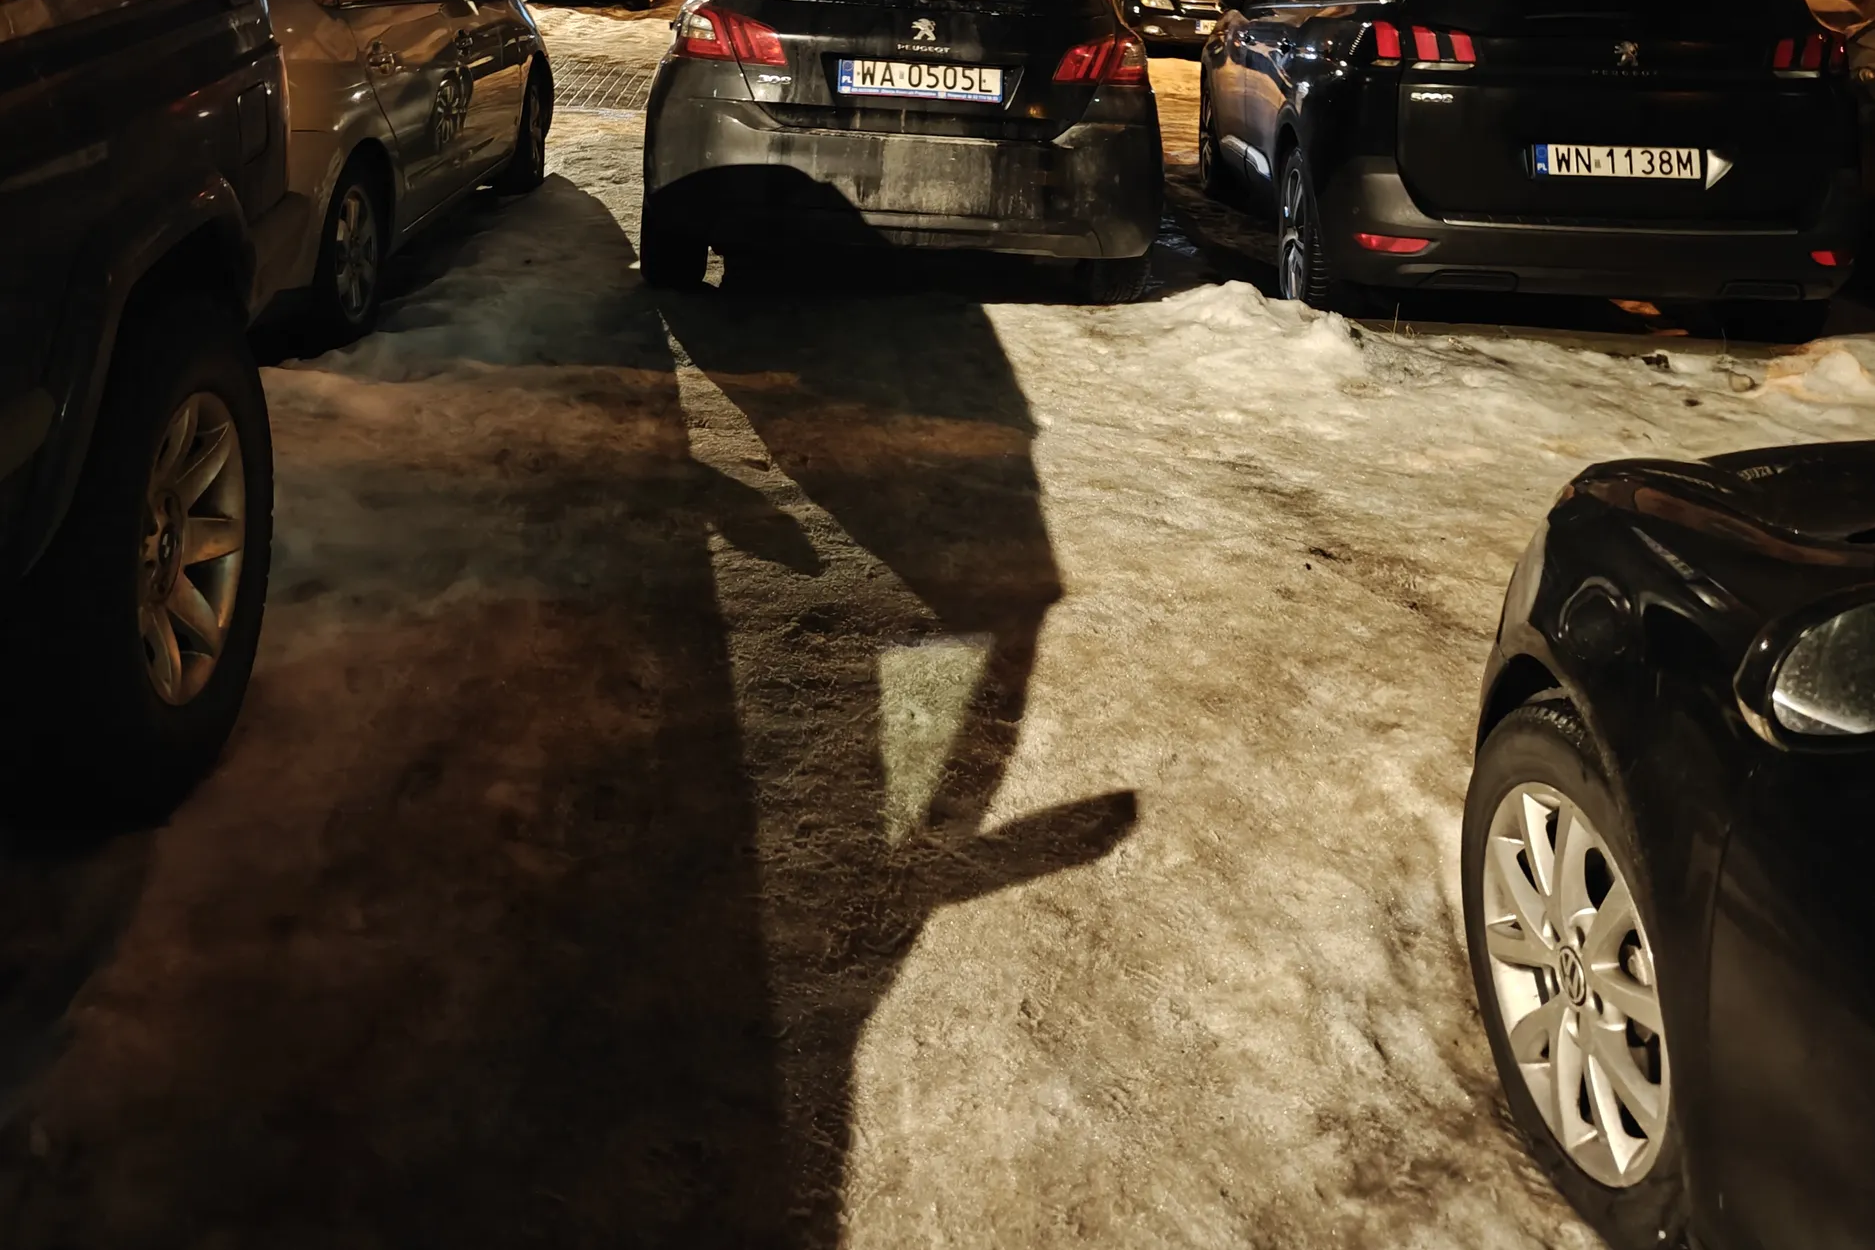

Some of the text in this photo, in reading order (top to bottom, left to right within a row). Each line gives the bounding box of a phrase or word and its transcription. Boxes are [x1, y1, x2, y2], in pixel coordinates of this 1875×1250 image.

[897, 43, 951, 54] PEUGEOT
[861, 60, 895, 87] WA
[908, 64, 993, 93] 0505L
[1555, 147, 1592, 174] WN
[1606, 148, 1694, 177] 1138M
